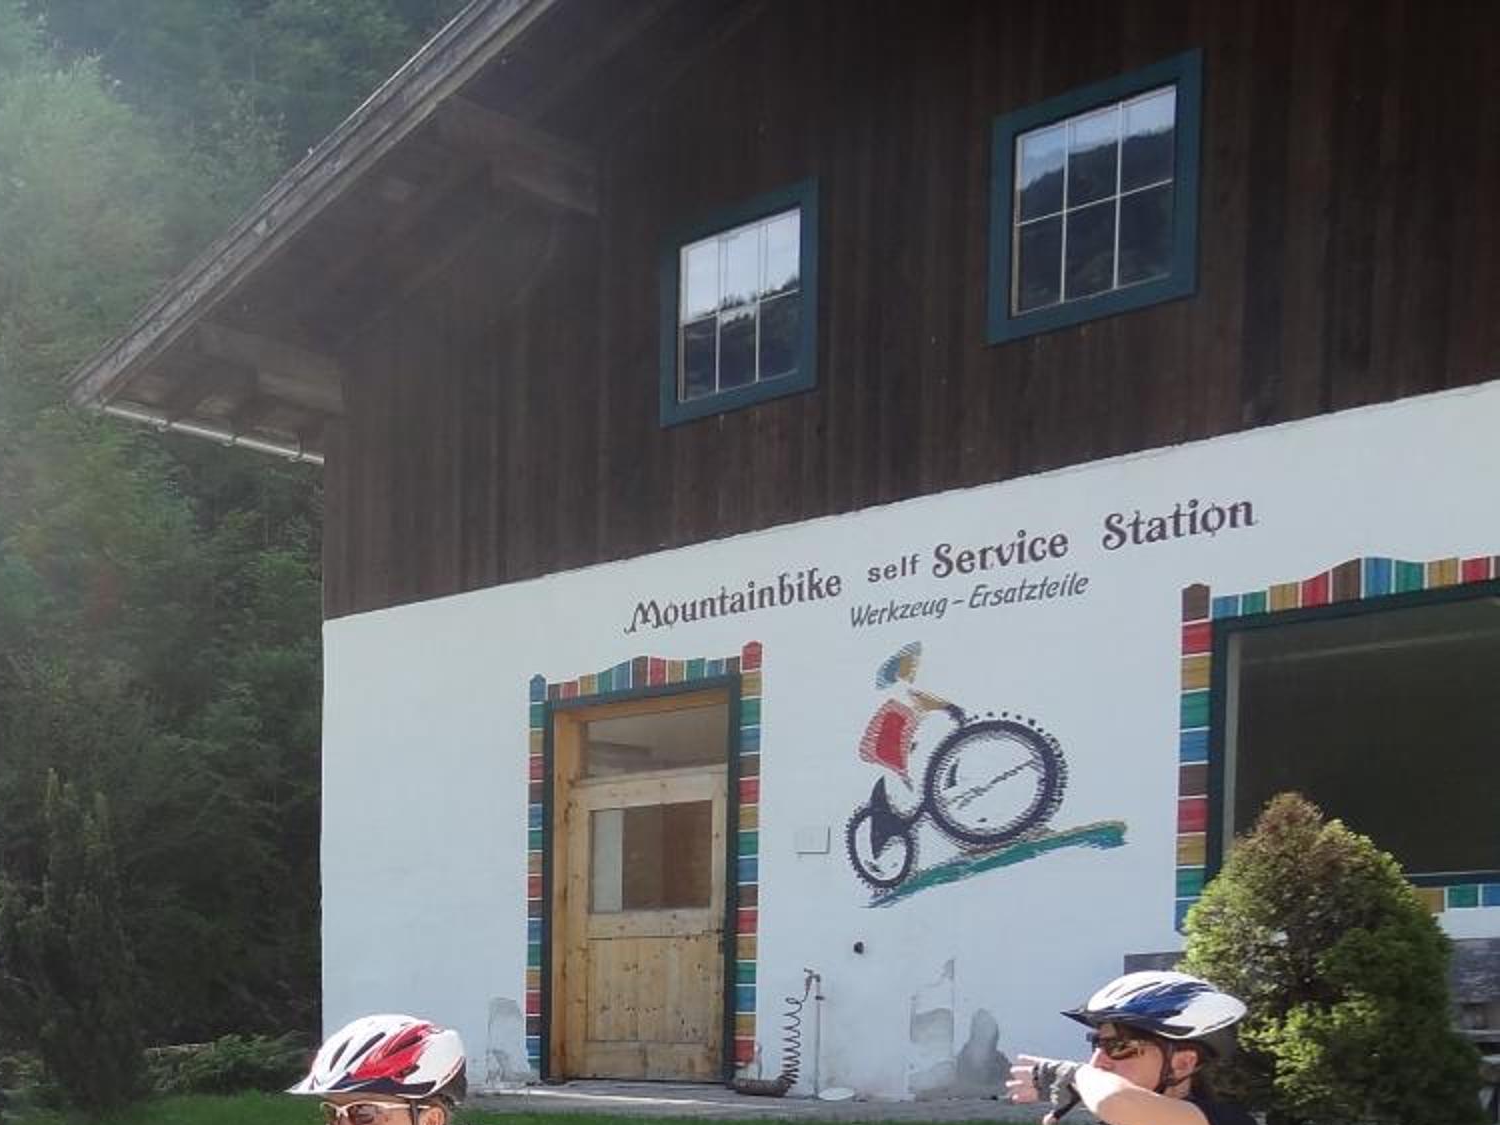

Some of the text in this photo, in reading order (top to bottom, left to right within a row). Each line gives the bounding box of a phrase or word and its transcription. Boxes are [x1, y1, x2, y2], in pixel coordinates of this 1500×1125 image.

[624, 498, 1258, 634] Mountainbike self Service Station
[968, 572, 1089, 609] Ersatzteile
